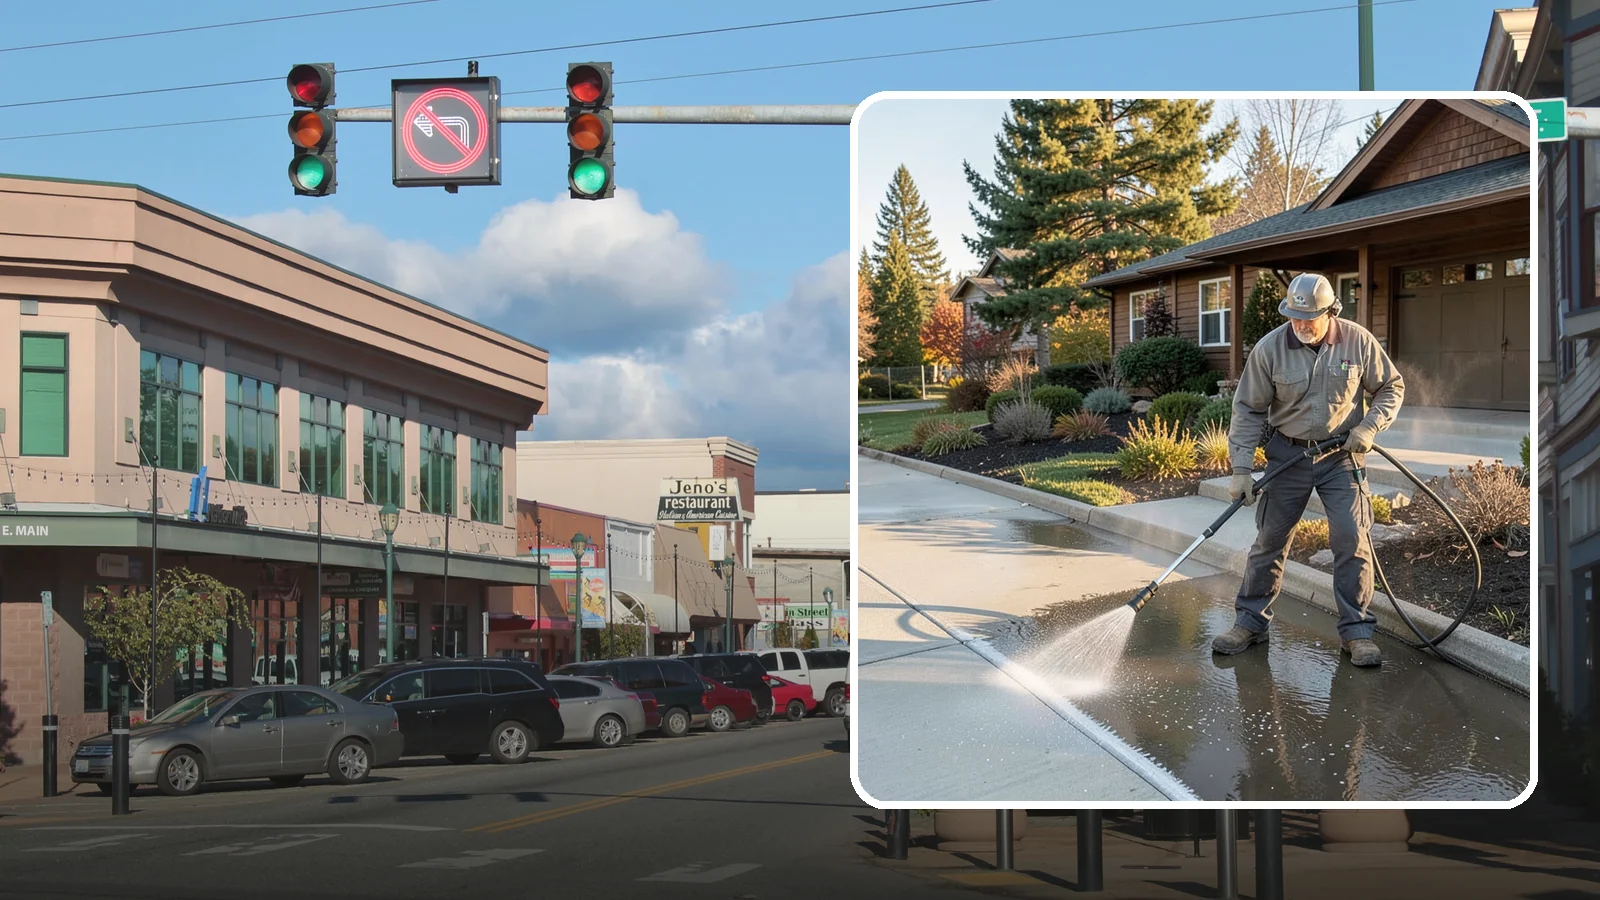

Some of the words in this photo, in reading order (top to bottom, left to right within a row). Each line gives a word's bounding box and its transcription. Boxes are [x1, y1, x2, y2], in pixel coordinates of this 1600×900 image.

[670, 480, 727, 494] Jeno's
[665, 496, 731, 509] restaurant
[659, 510, 681, 519] Italian
[686, 510, 714, 519] American
[715, 509, 737, 519] Cuisine
[2, 525, 13, 536] E.
[15, 525, 49, 536] MAIN
[797, 607, 828, 617] Street
